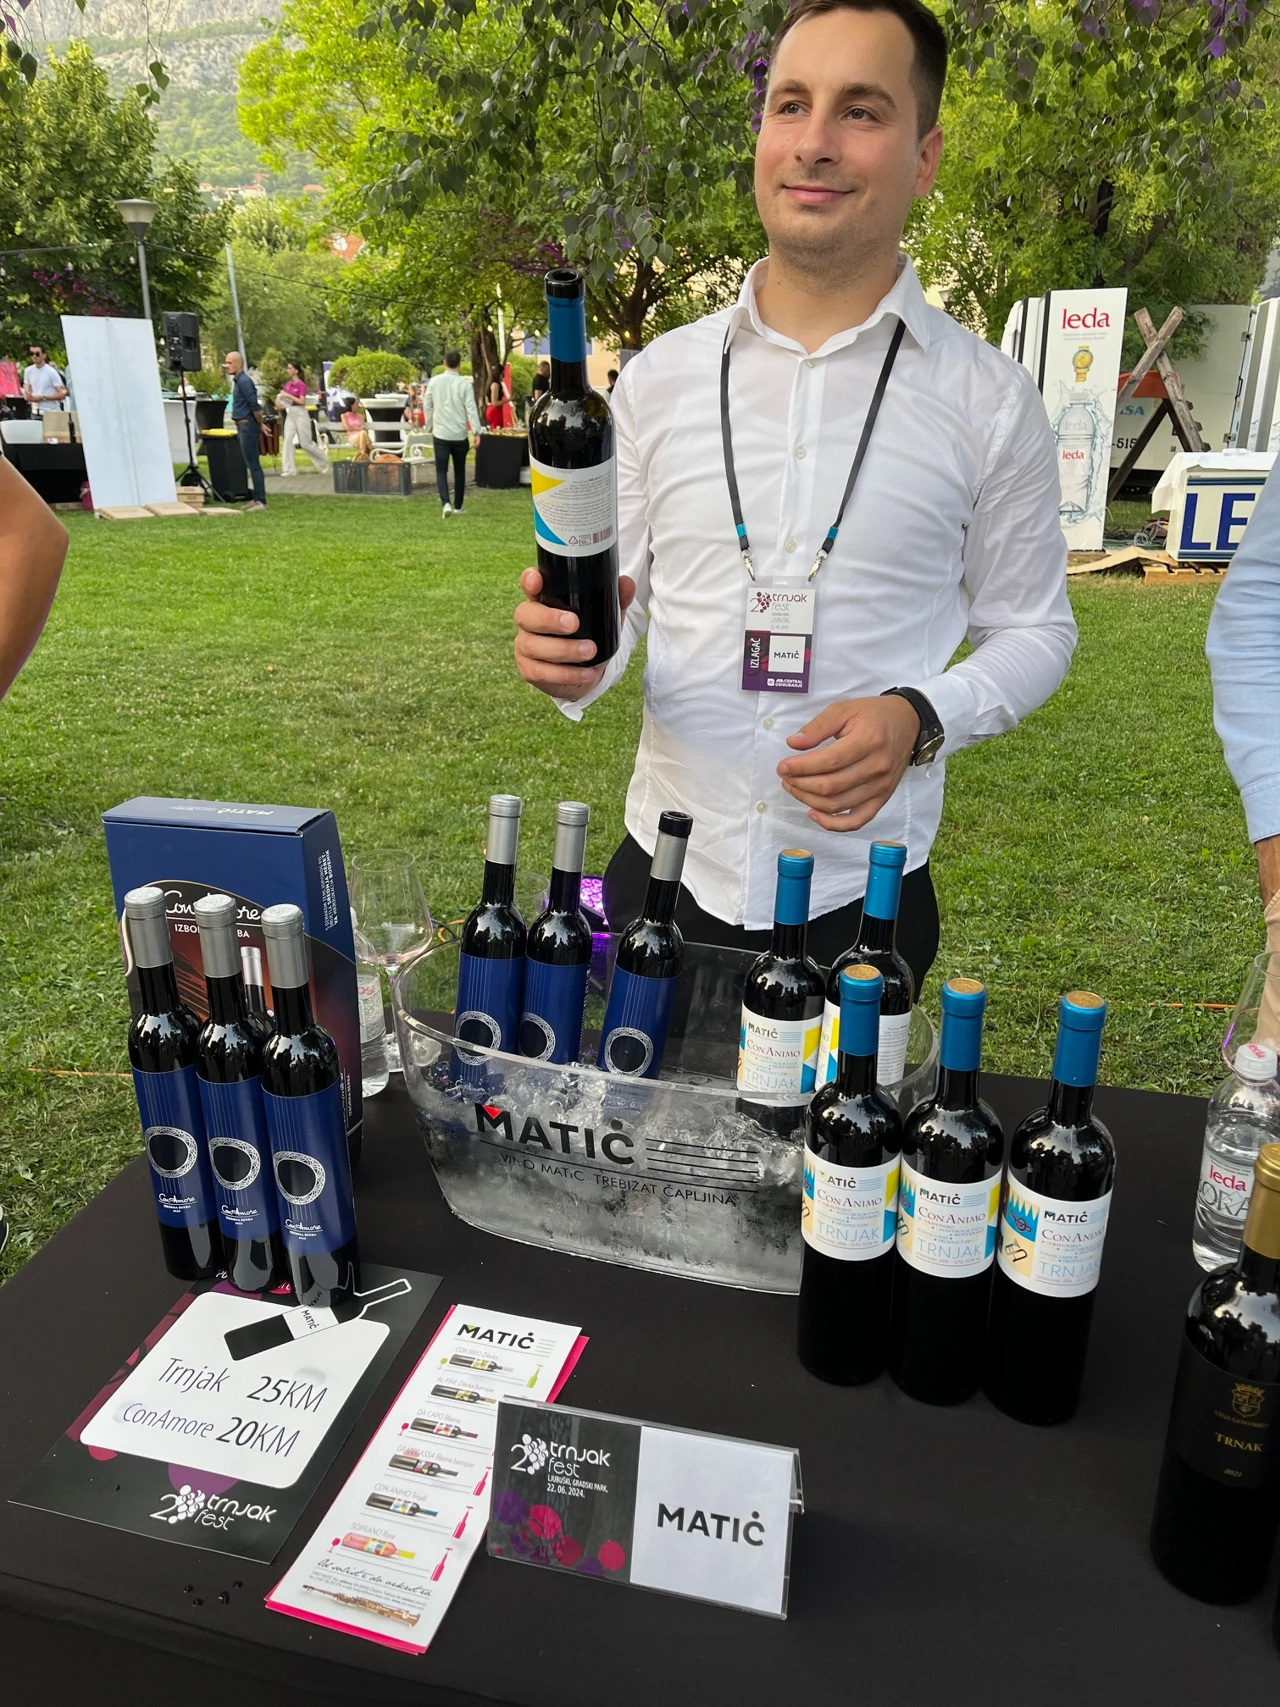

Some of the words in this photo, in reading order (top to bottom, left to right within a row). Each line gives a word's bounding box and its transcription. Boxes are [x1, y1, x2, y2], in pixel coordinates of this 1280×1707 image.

[1062, 307, 1110, 329] leda
[1063, 450, 1084, 460] leda
[772, 593, 808, 603] trnjak
[745, 1069, 799, 1090] TRNJAK
[1209, 1164, 1247, 1192] leda
[817, 1220, 879, 1242] TRNJAK
[917, 1237, 982, 1259] TRNJAK
[158, 1357, 231, 1393] Trnjak
[246, 1375, 328, 1414] 25KM
[123, 1402, 215, 1438] ConAmore
[215, 1416, 300, 1458] 20KM
[1214, 1432, 1264, 1452] TRNAK
[550, 1441, 611, 1467] trnjak
[548, 1457, 580, 1478] fest
[194, 1507, 234, 1532] fest
[206, 1494, 278, 1524] trnjak
